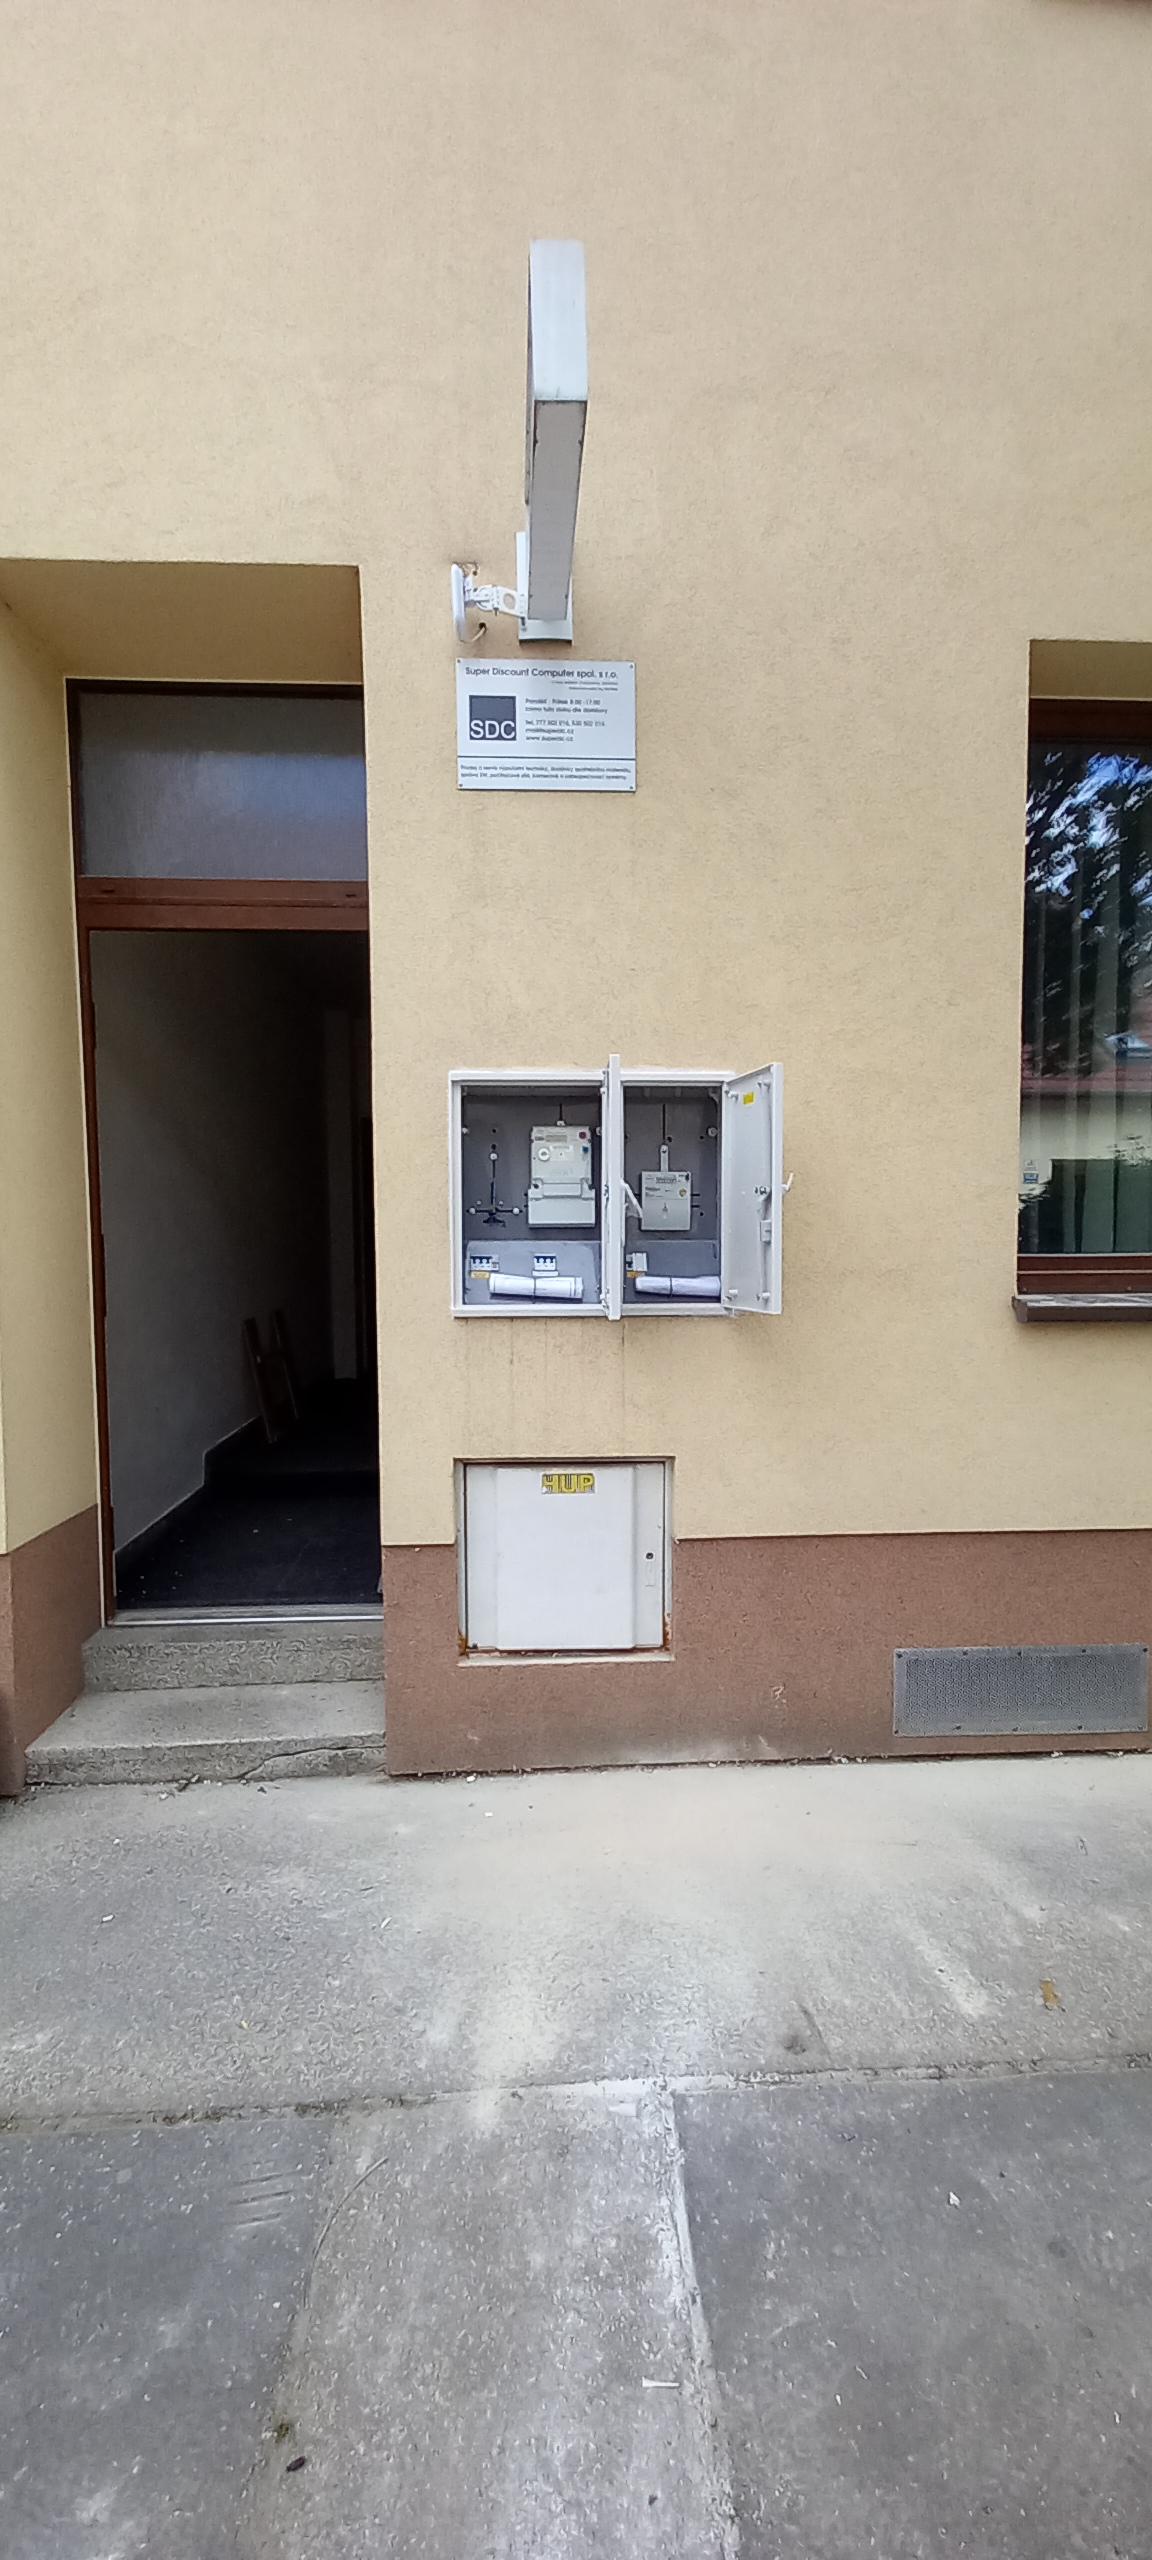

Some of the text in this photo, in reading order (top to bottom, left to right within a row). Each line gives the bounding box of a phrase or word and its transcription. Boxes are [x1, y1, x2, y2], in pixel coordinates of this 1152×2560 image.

[465, 667, 490, 677] Super
[492, 667, 530, 676] Discount
[531, 668, 574, 679] Computer
[576, 669, 598, 679] spol.
[604, 671, 618, 679] r.o.
[470, 719, 516, 739] SDC
[542, 1473, 595, 1494] HUP
